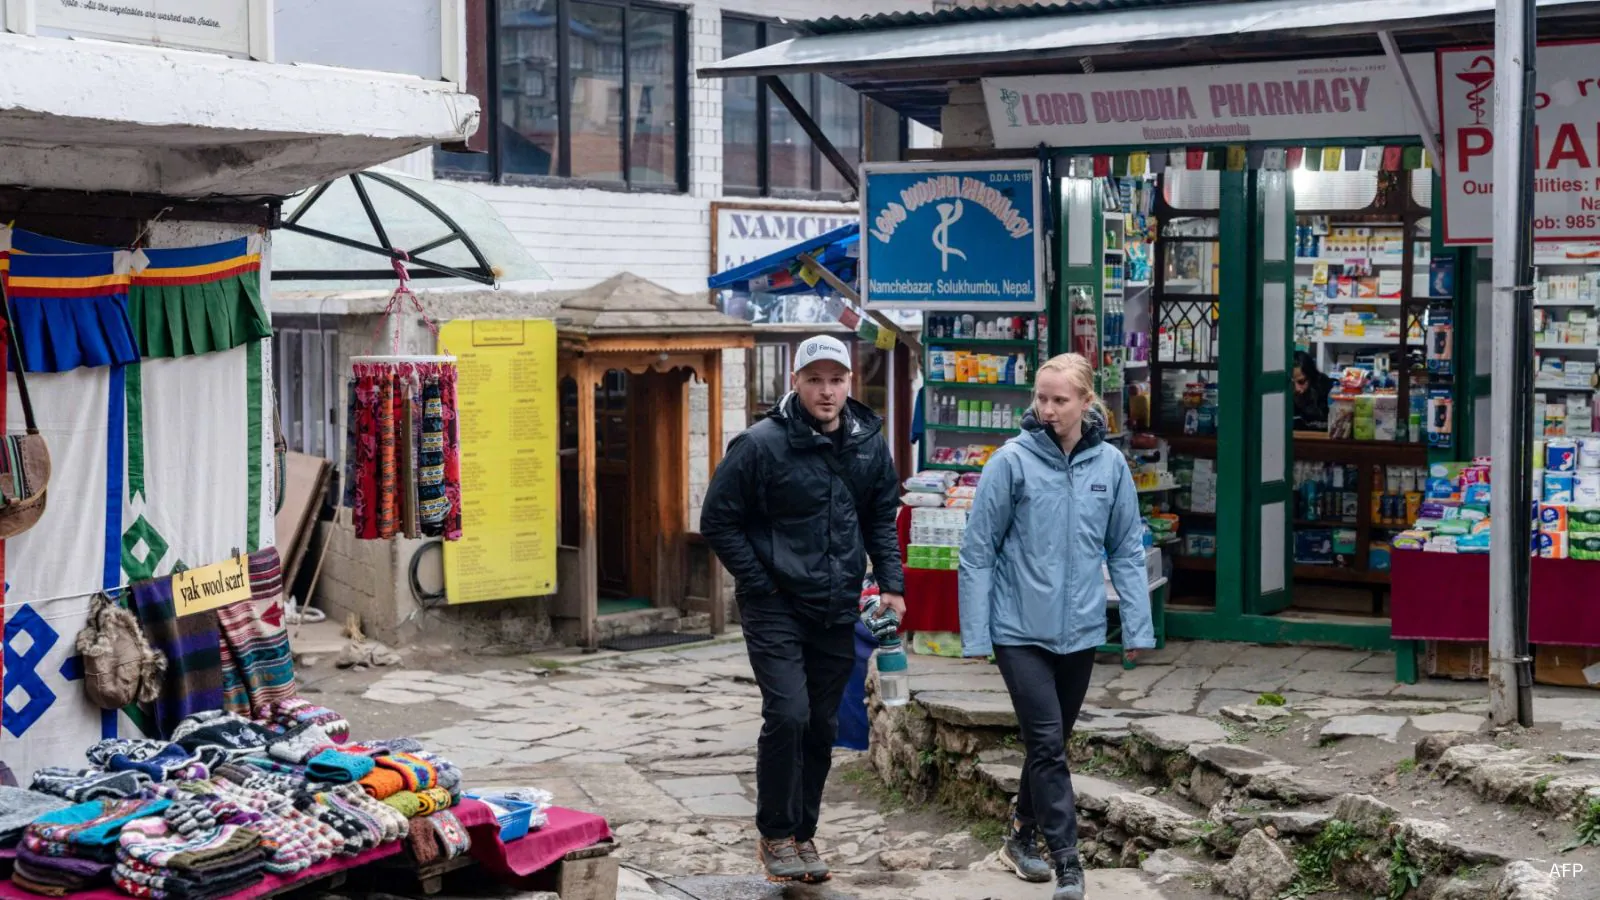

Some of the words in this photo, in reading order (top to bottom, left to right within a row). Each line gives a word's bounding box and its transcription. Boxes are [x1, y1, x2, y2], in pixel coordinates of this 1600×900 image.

[98, 2, 108, 12] the
[109, 5, 144, 17] vegetables
[144, 11, 156, 19] are
[157, 11, 182, 23] washed
[182, 15, 196, 25] with
[1022, 92, 1088, 126] LORD
[1090, 86, 1197, 124] BUDDHA
[1208, 76, 1370, 119] PHARMACY
[1142, 125, 1187, 140] Namche,
[1187, 122, 1251, 138] Solukhumbu
[989, 173, 1011, 182] D.D.A.
[869, 202, 907, 244] LORD
[900, 175, 961, 212] BUDDHA
[961, 176, 1033, 239] PHARMACY
[1534, 215, 1560, 229] ob:
[869, 279, 935, 297] Namchebazar,
[936, 278, 1001, 297] Solukhumbu,
[1002, 279, 1033, 298] Nepal.
[180, 576, 201, 607] yak
[201, 570, 225, 597] wool
[225, 564, 245, 592] scarf
